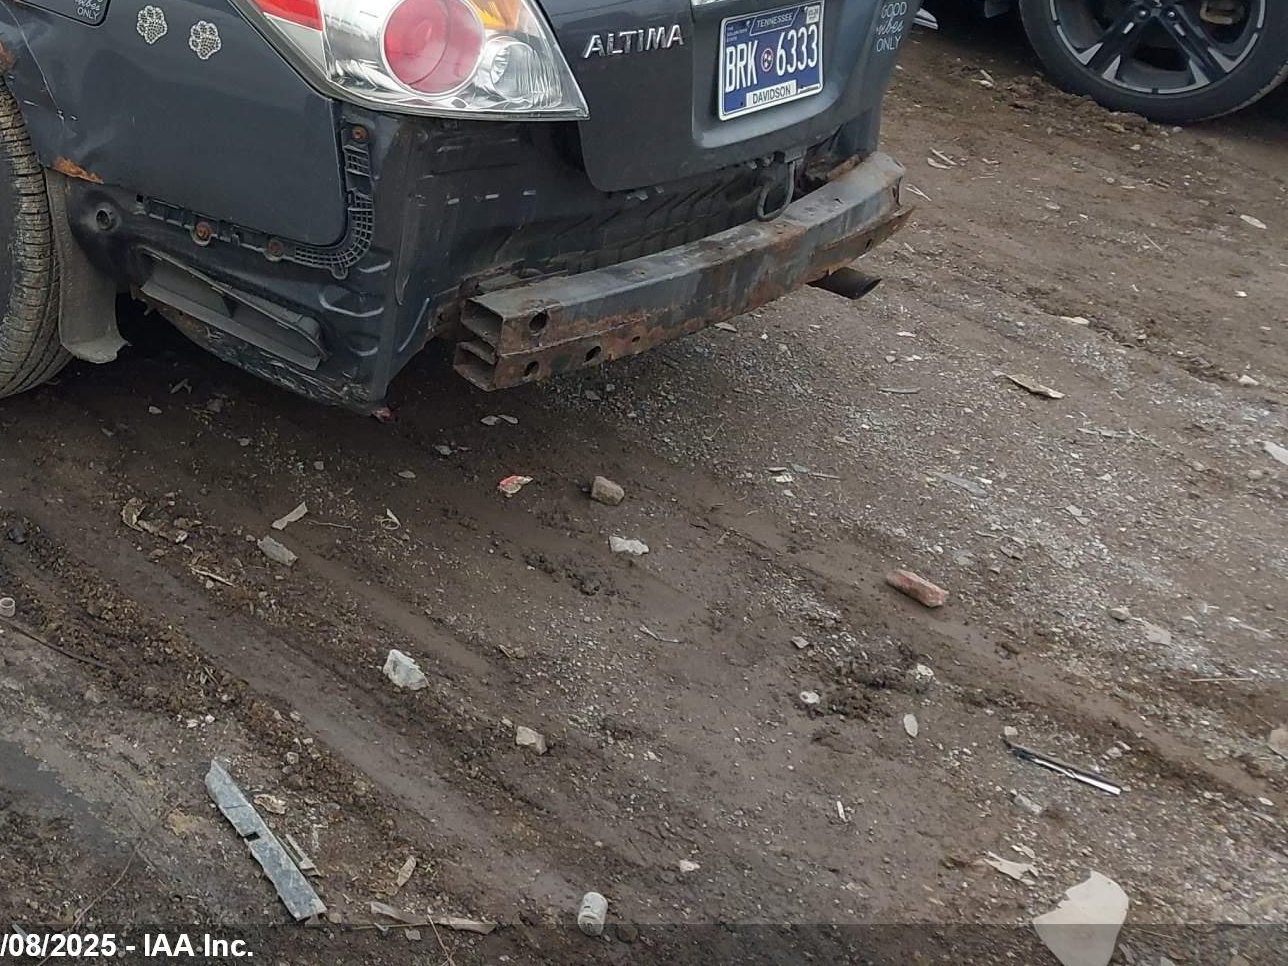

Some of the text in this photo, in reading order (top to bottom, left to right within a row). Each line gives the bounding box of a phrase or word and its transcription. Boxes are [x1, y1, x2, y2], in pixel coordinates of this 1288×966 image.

[78, 7, 99, 21] ONLY
[881, 1, 907, 19] GOOD
[757, 13, 792, 28] TENNESSEE
[582, 25, 684, 58] ALTIMA
[876, 35, 902, 52] ONLY
[725, 24, 818, 93] BRK 6333
[752, 84, 791, 104] DAVIDSON
